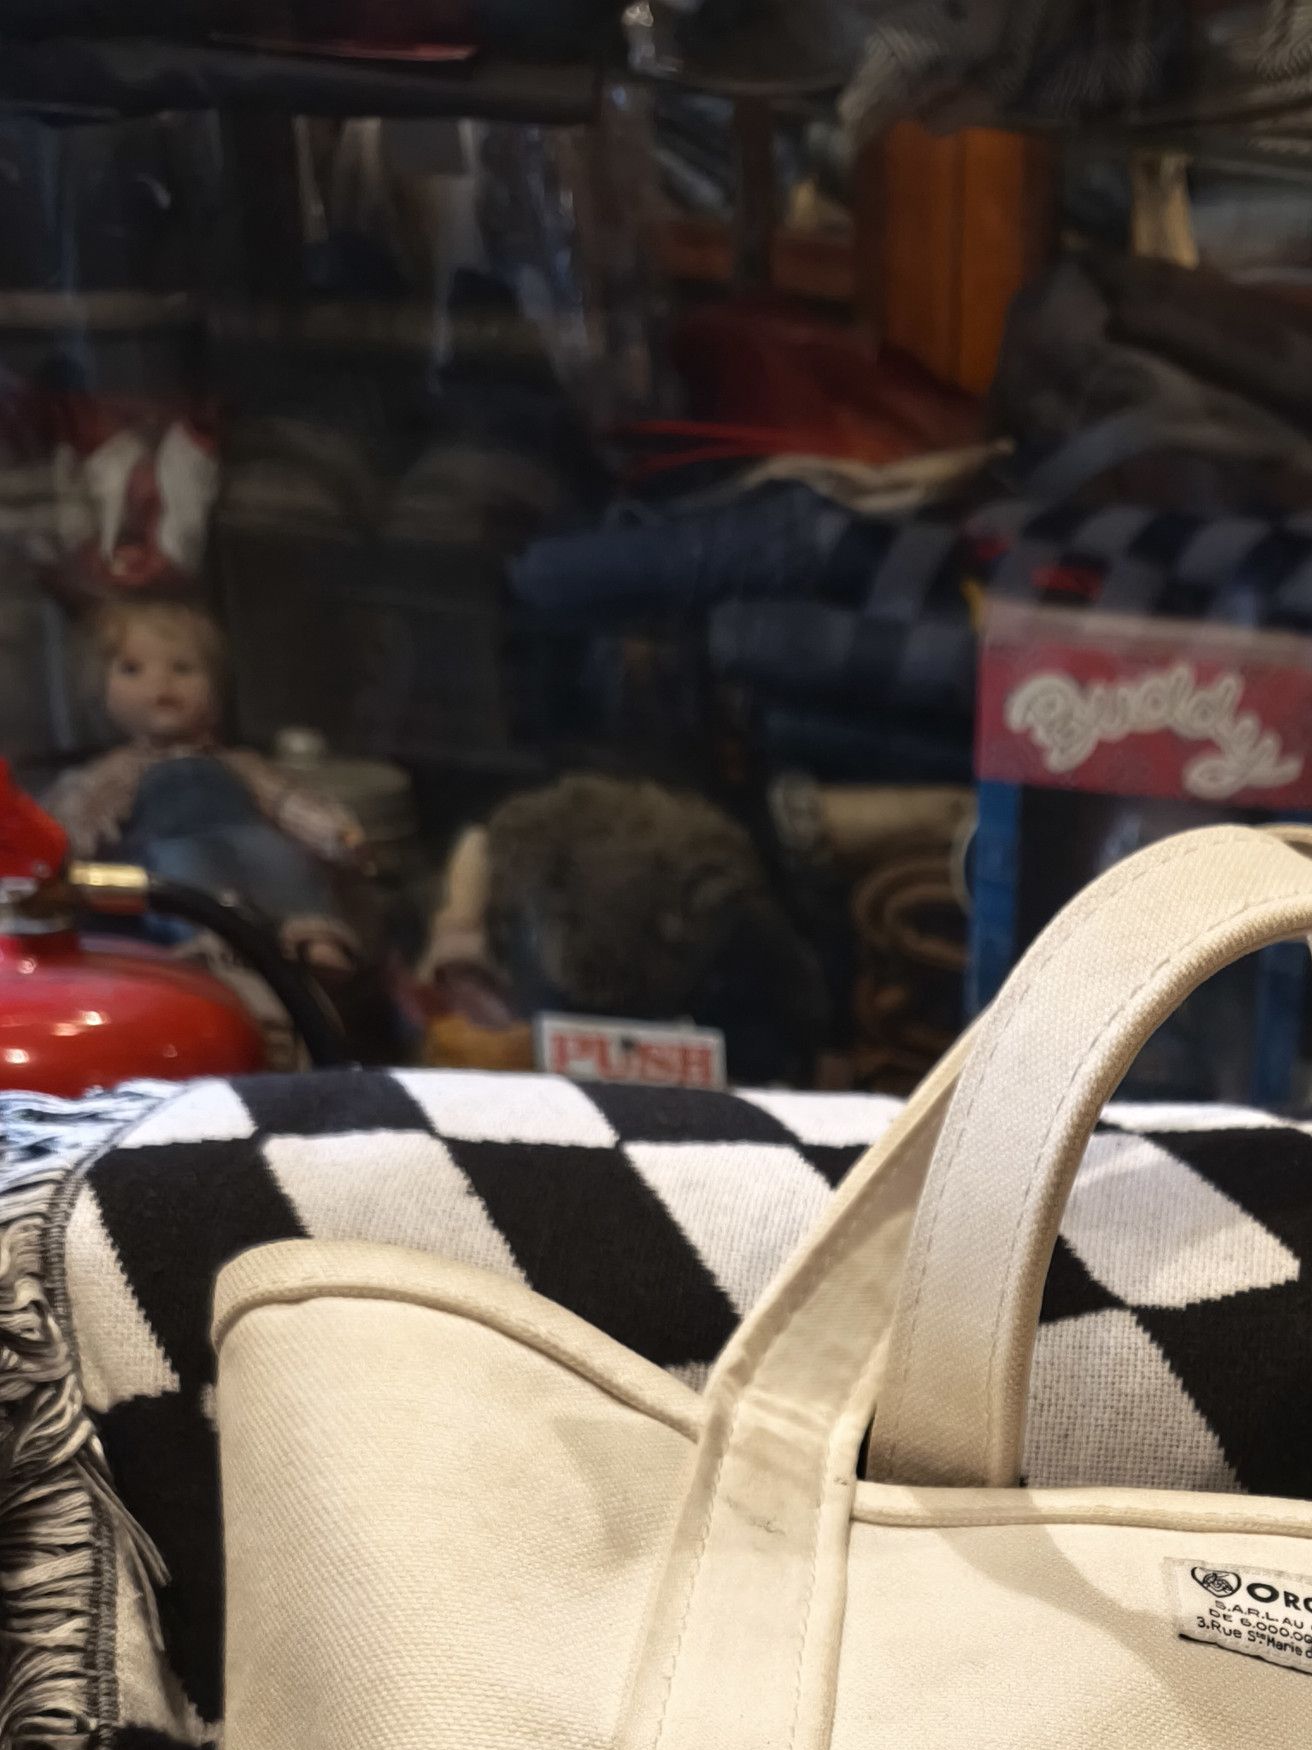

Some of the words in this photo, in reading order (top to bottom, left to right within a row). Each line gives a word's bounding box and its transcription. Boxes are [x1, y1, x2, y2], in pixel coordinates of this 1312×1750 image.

[1004, 662, 1304, 800] Buddy
[549, 1032, 716, 1087] PUSH
[1208, 1608, 1232, 1623] DE
[1282, 1617, 1304, 1630] AU
